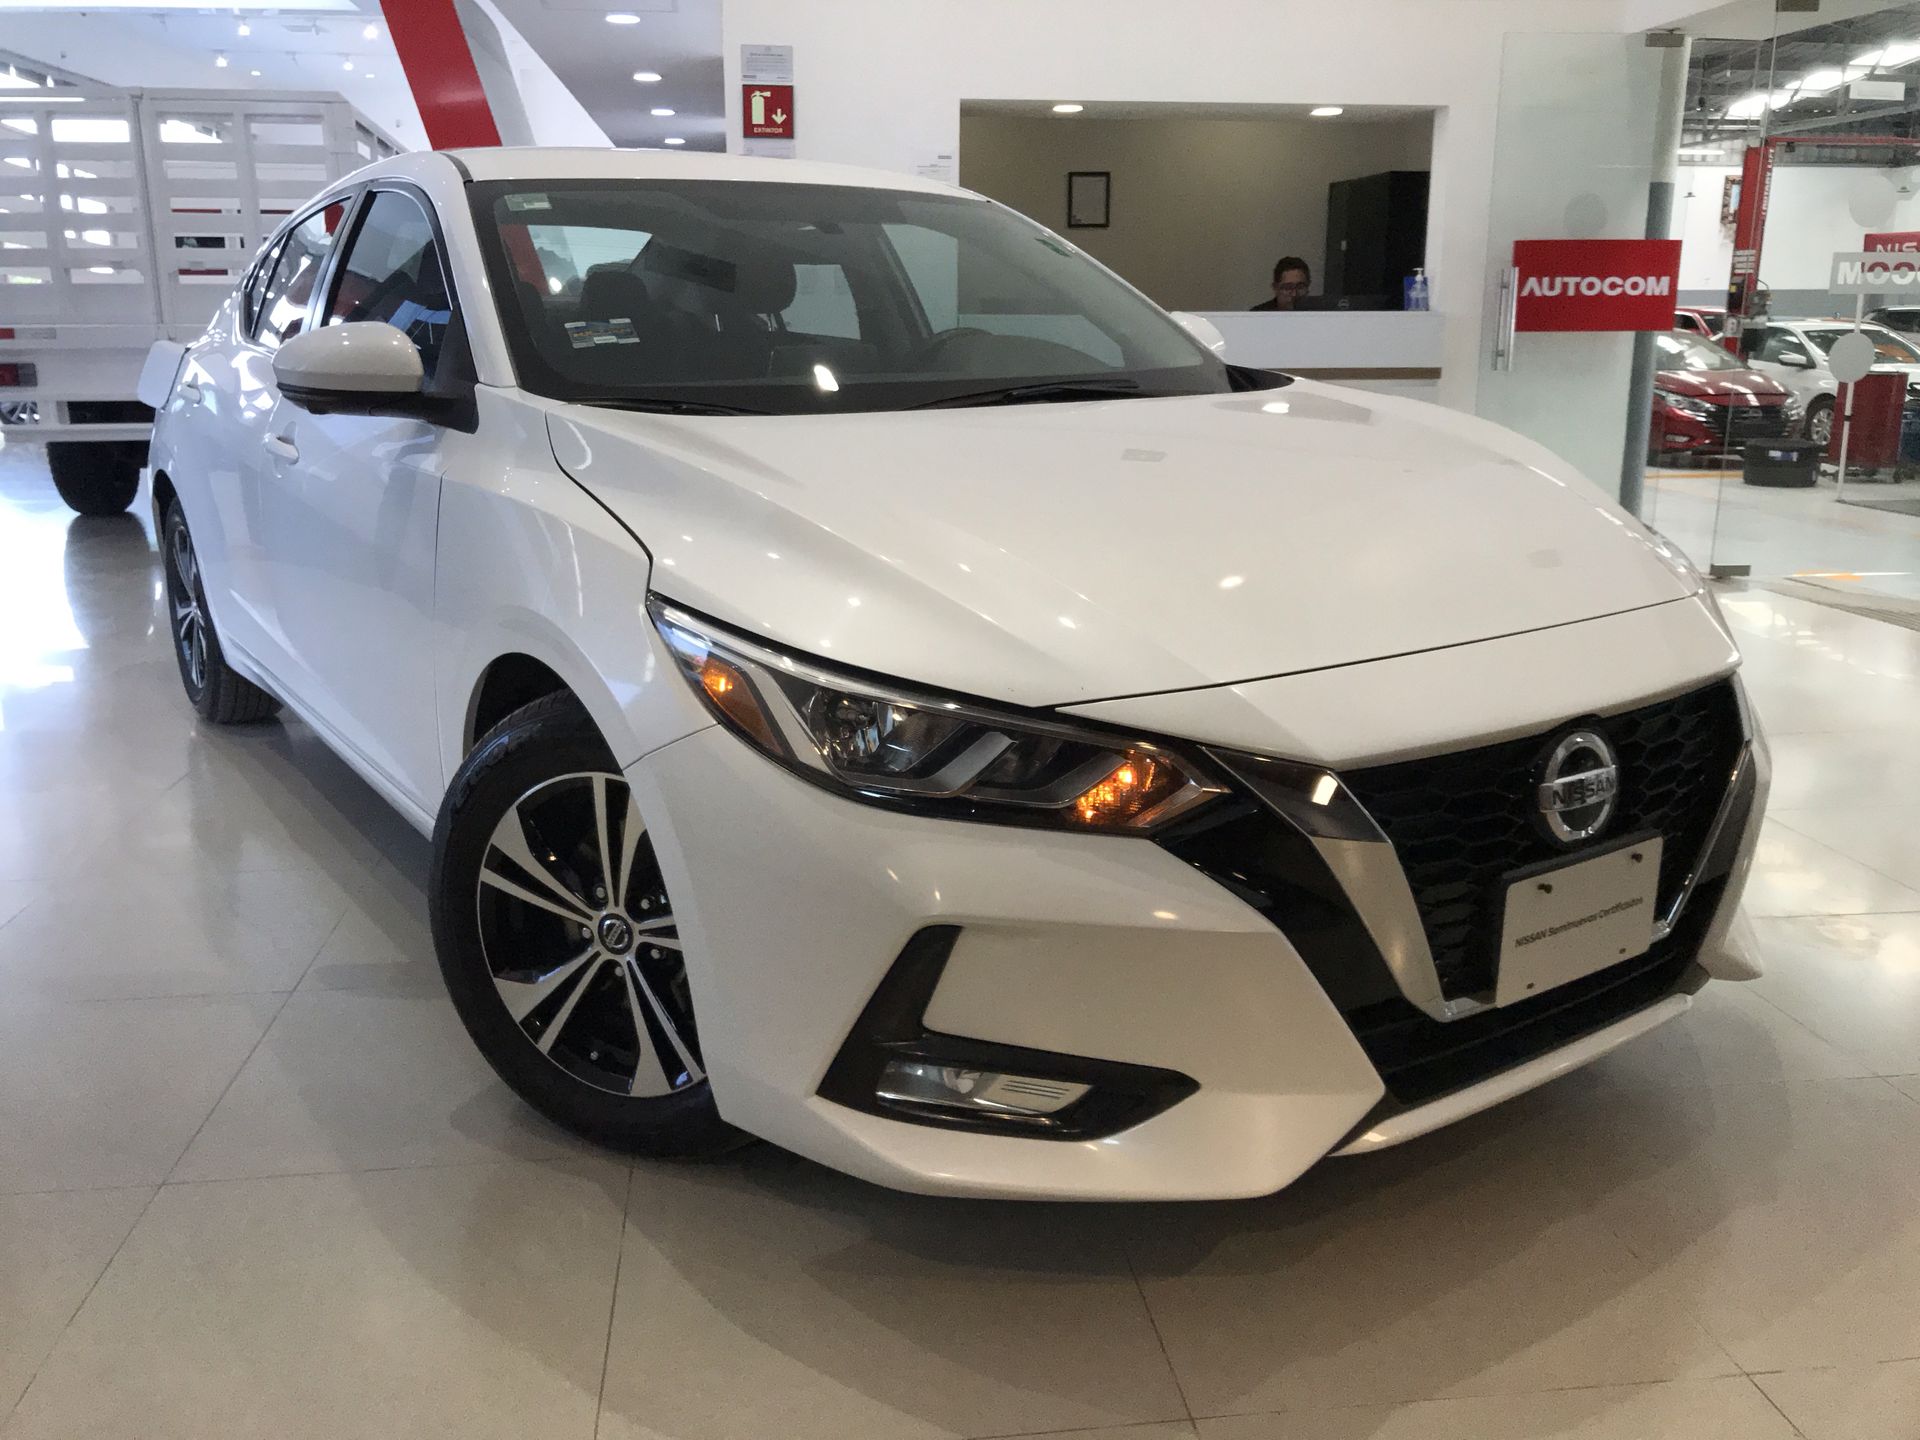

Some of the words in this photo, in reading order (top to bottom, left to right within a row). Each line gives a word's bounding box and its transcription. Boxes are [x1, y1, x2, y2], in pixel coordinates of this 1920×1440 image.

[1520, 276, 1670, 297] AUTOCOM
[1552, 776, 1612, 805] NISSAN
[1515, 929, 1547, 947] NISSAN
